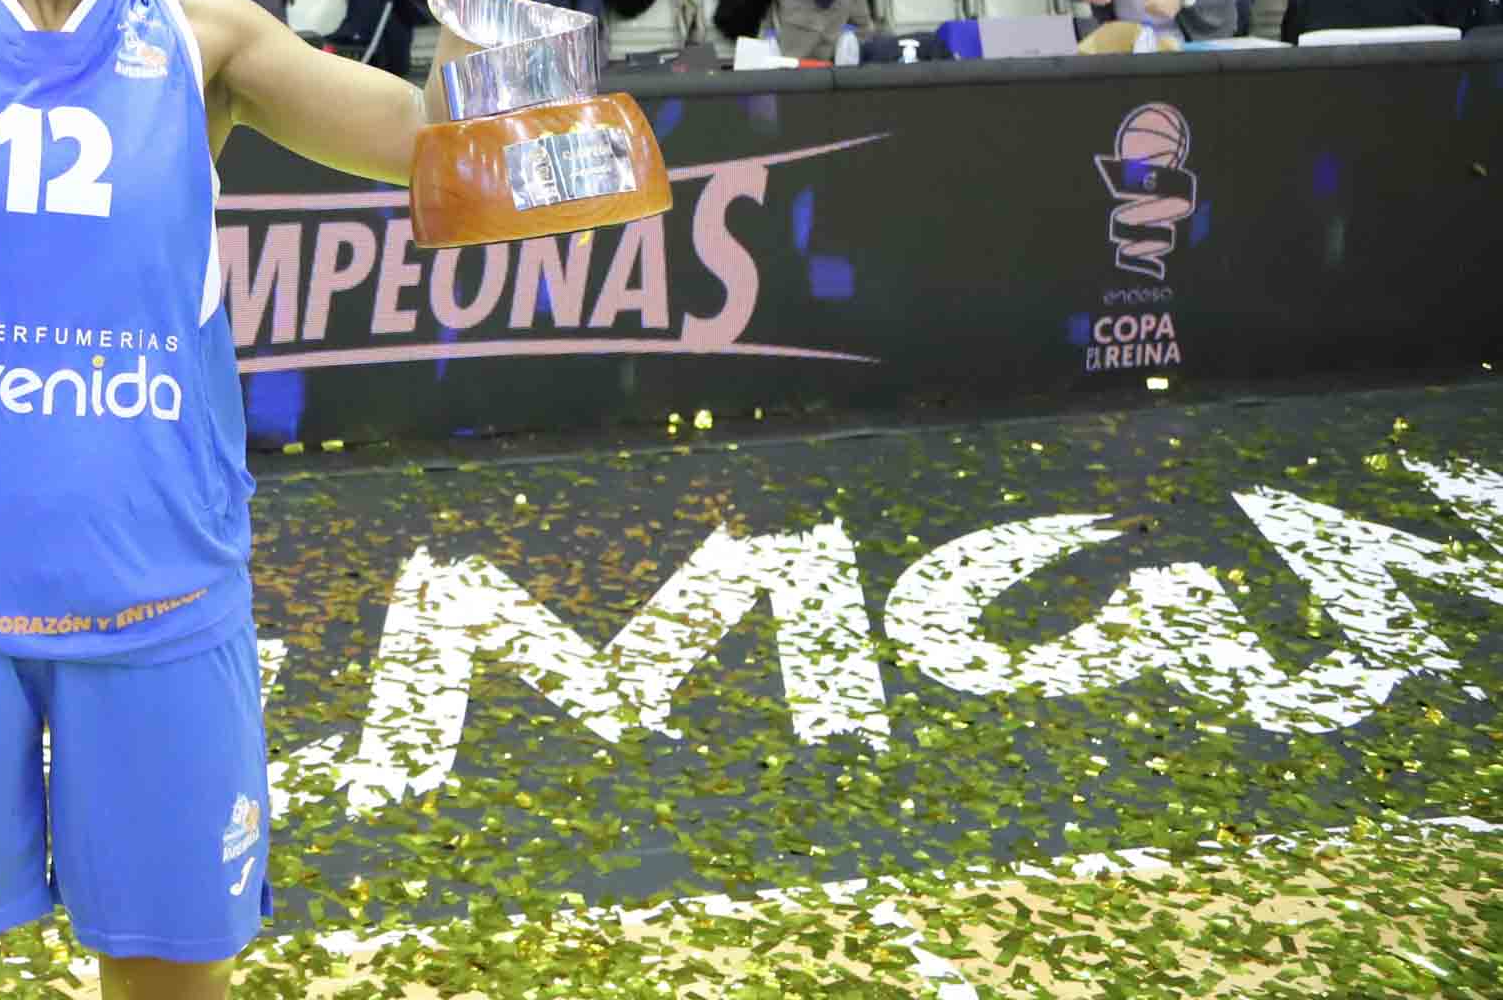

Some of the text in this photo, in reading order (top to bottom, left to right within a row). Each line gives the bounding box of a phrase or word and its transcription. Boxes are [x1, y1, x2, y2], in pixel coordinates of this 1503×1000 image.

[218, 163, 769, 347] MPEONAS
[1094, 313, 1176, 344] COPA
[1105, 341, 1182, 369] REINA
[96, 617, 112, 632] Y
